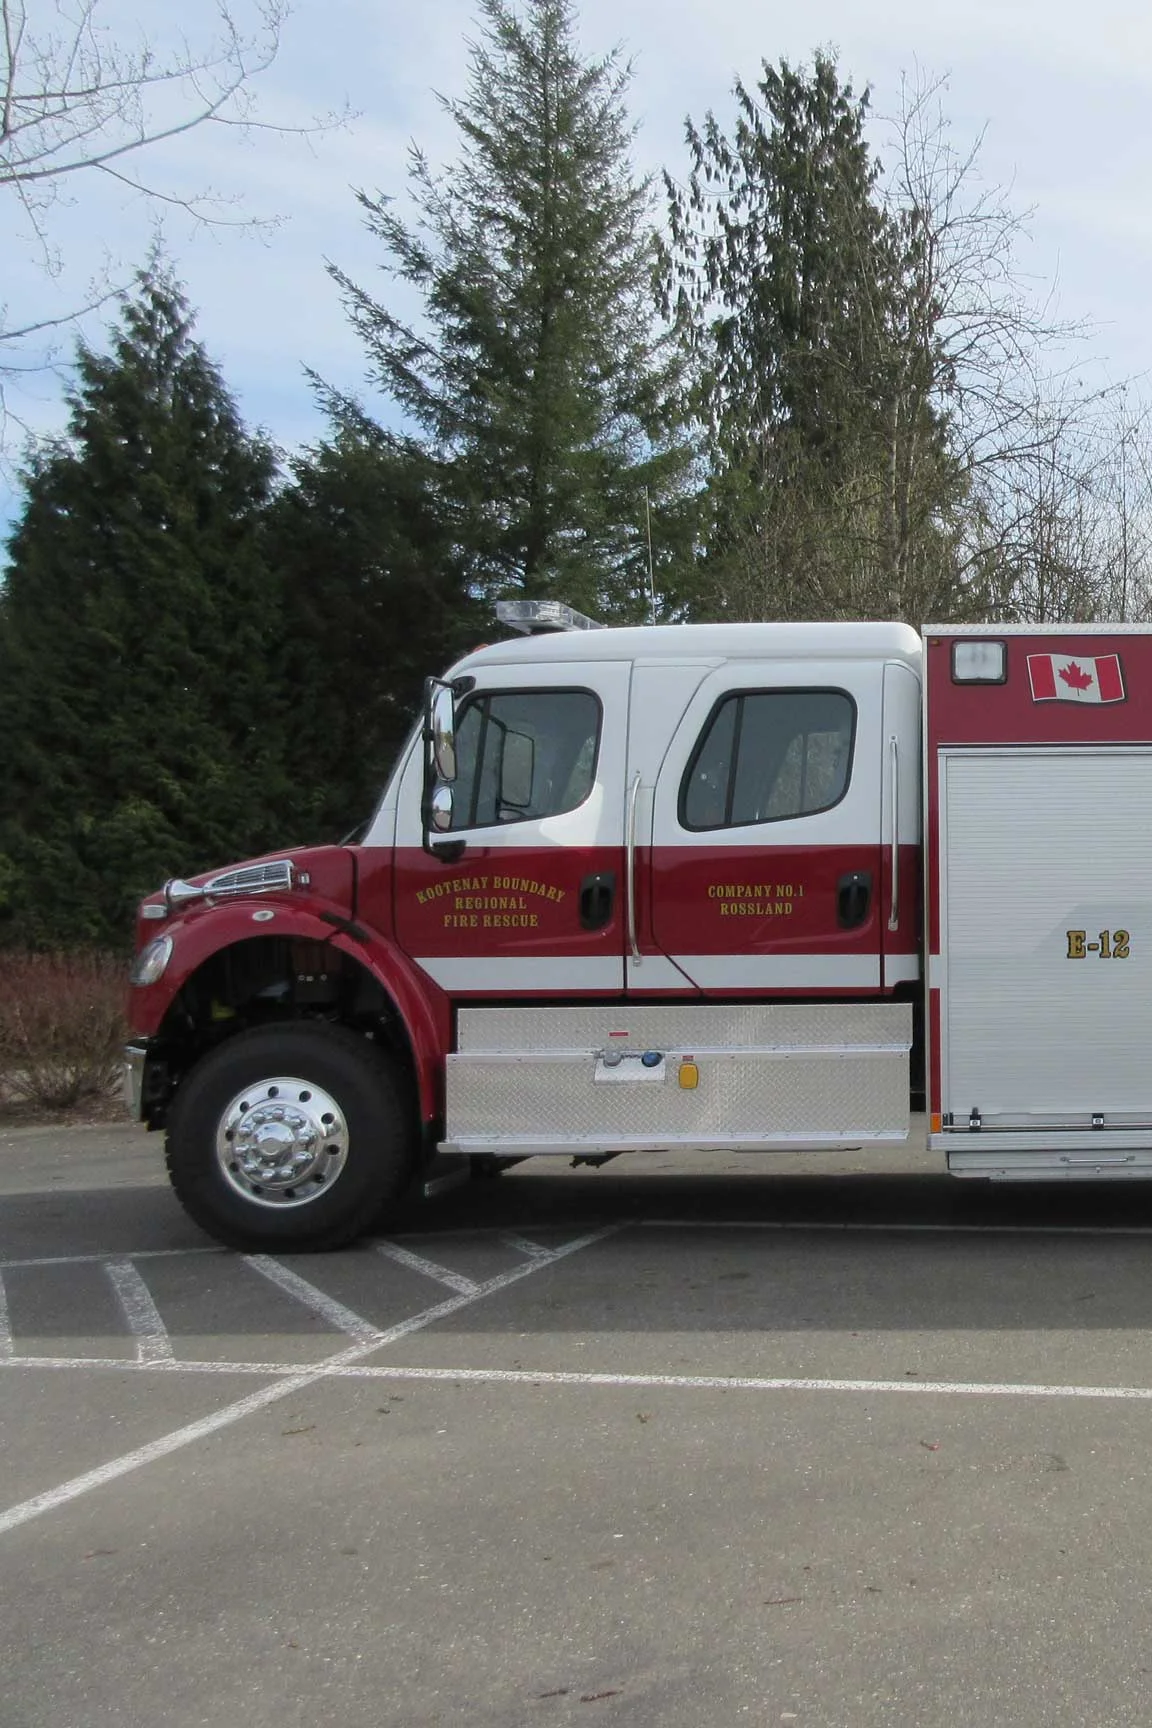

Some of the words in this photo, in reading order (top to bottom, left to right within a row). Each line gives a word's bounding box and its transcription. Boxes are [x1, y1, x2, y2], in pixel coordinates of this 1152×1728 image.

[416, 876, 489, 904] KOOTENAY
[493, 876, 566, 903] BOUNDARY
[708, 885, 771, 898] COMPANY
[455, 897, 527, 910] REGIONAL
[720, 902, 793, 915] ROSSLAND
[443, 914, 478, 928] FIRE
[483, 914, 539, 928] RESCUE
[1066, 930, 1130, 959] E-12
